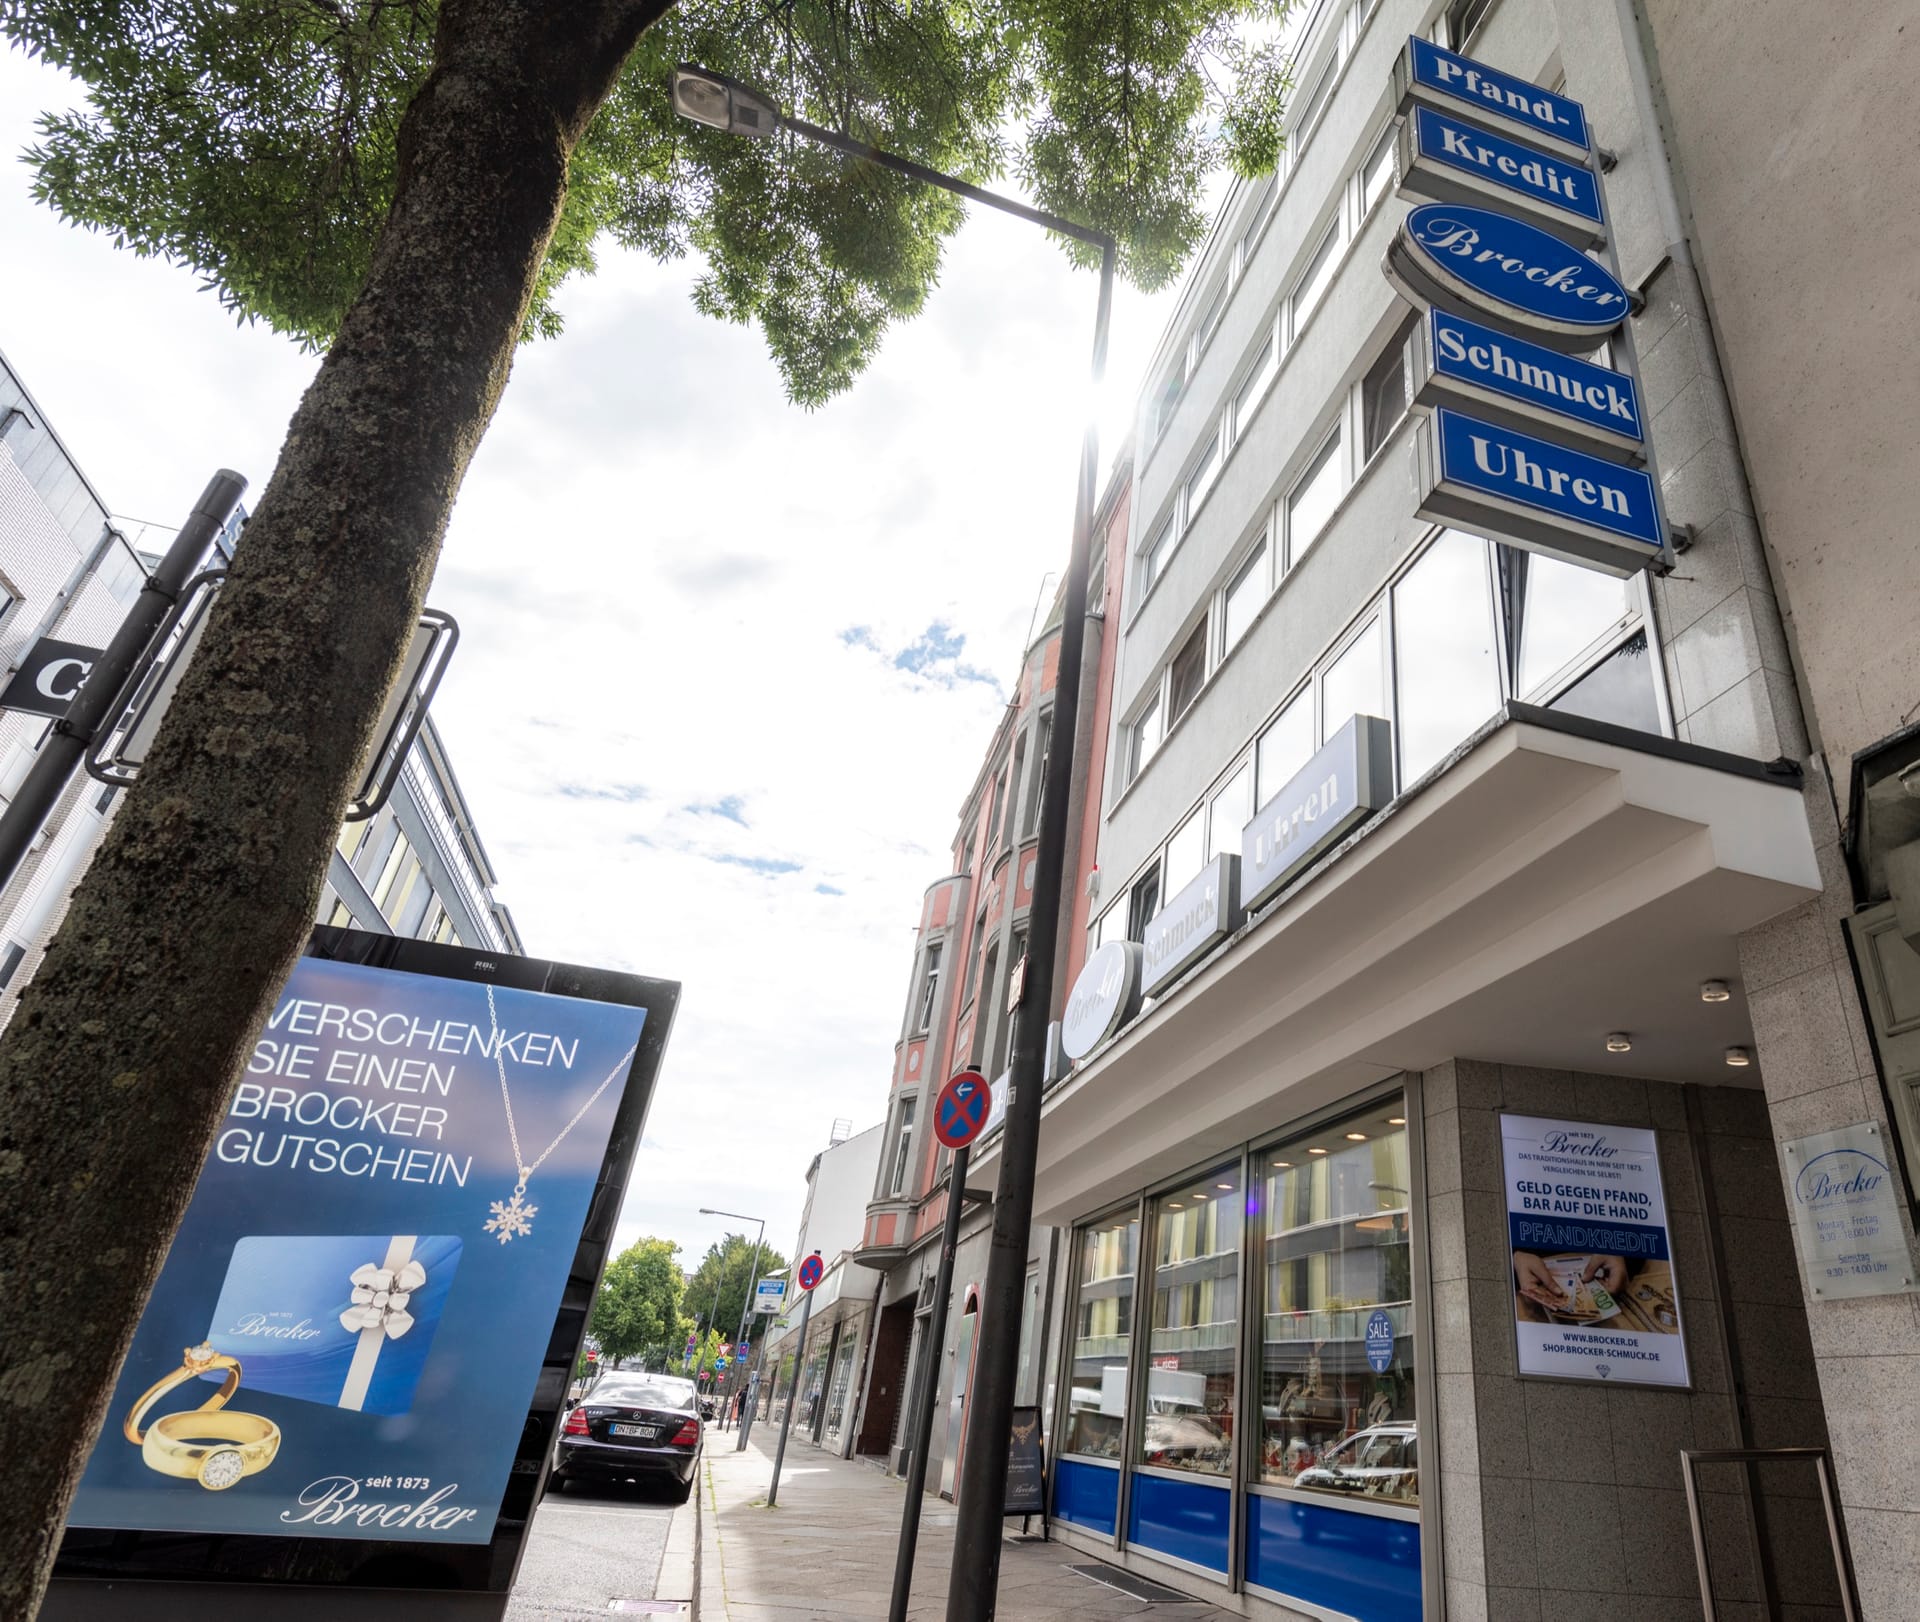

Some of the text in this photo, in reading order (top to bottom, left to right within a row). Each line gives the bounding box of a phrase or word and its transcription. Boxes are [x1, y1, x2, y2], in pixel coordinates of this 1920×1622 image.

[1433, 56, 1570, 125] Pfand-
[1440, 126, 1578, 200] Kredit
[1416, 218, 1623, 306] Brocker
[1438, 327, 1635, 421] Schmuck
[1469, 435, 1632, 518] Uhren
[1255, 773, 1339, 873] Uhren
[1145, 885, 1216, 968] Schmuck
[267, 999, 579, 1069] VERSCHENKEN
[247, 1040, 455, 1096] SIE EINEN
[230, 1083, 448, 1140] BROCKER
[216, 1128, 472, 1187] GUTSCHEIN
[1540, 1131, 1618, 1158] Brocker
[1518, 1153, 1532, 1161] DAS
[1532, 1153, 1587, 1166] TRADITIONSHAUS
[1612, 1162, 1625, 1170] SEIT
[1543, 1165, 1586, 1176] VERGLEICHEN
[1516, 1181, 1652, 1207] GELD GEGEN PFAND,
[1805, 1165, 1883, 1201] Brocker
[1523, 1197, 1649, 1220] BAR AUF DIE HAND
[1852, 1215, 1878, 1225] Freitag
[1519, 1221, 1658, 1254] PFANDKREDIT
[1865, 1226, 1879, 1236] Uhr
[1874, 1263, 1888, 1273] Uhr
[228, 1312, 321, 1340] Brocker
[1368, 1321, 1390, 1339] SALE
[1562, 1332, 1639, 1347] WWW.BROCKER.DE
[1542, 1343, 1660, 1361] SHOP.BROCKER-SCHMUCK.DE
[365, 1475, 430, 1490] seit 1873
[279, 1475, 478, 1530] Brocker
